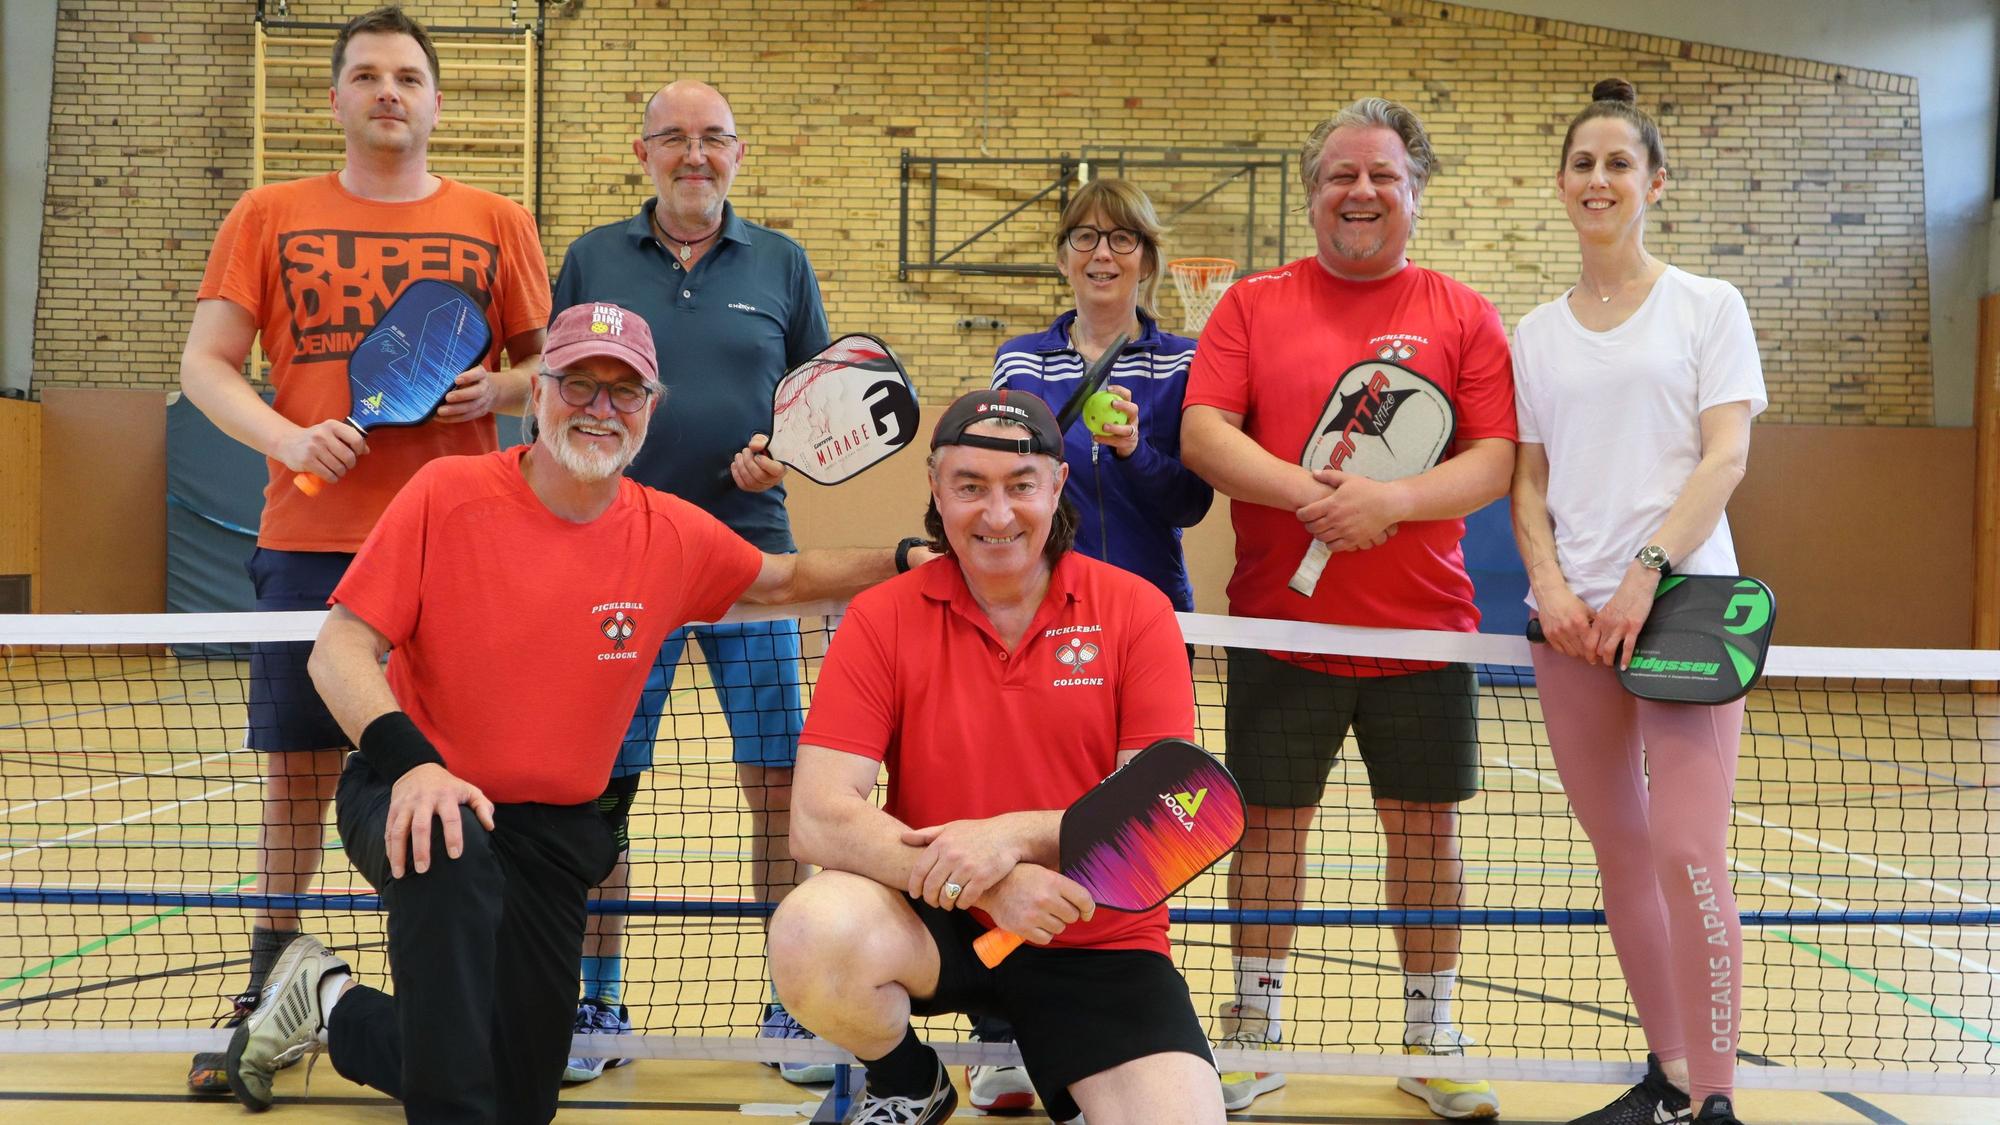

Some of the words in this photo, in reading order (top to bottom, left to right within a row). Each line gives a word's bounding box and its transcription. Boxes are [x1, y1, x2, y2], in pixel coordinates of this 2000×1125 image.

[284, 234, 491, 291] SUPER
[592, 305, 625, 318] JUST
[592, 313, 623, 328] DINK
[610, 325, 624, 336] IT
[294, 331, 365, 355] DENIM
[1369, 333, 1429, 345] PICKLEBALL
[360, 398, 380, 416] JOOLA
[989, 403, 1029, 418] REBEL
[1323, 370, 1390, 471] ANTA
[816, 423, 871, 467] MIRAGE
[1045, 624, 1103, 638] PICKLEBAL
[597, 651, 638, 661] COLOGNE
[1628, 656, 1721, 675] Odyssey
[1053, 677, 1104, 687] COLOGNE
[1159, 792, 1195, 832] JOOLA
[1686, 863, 1729, 947] APART
[1258, 976, 1283, 989] FIL
[1709, 955, 1732, 1054] OCEANS
